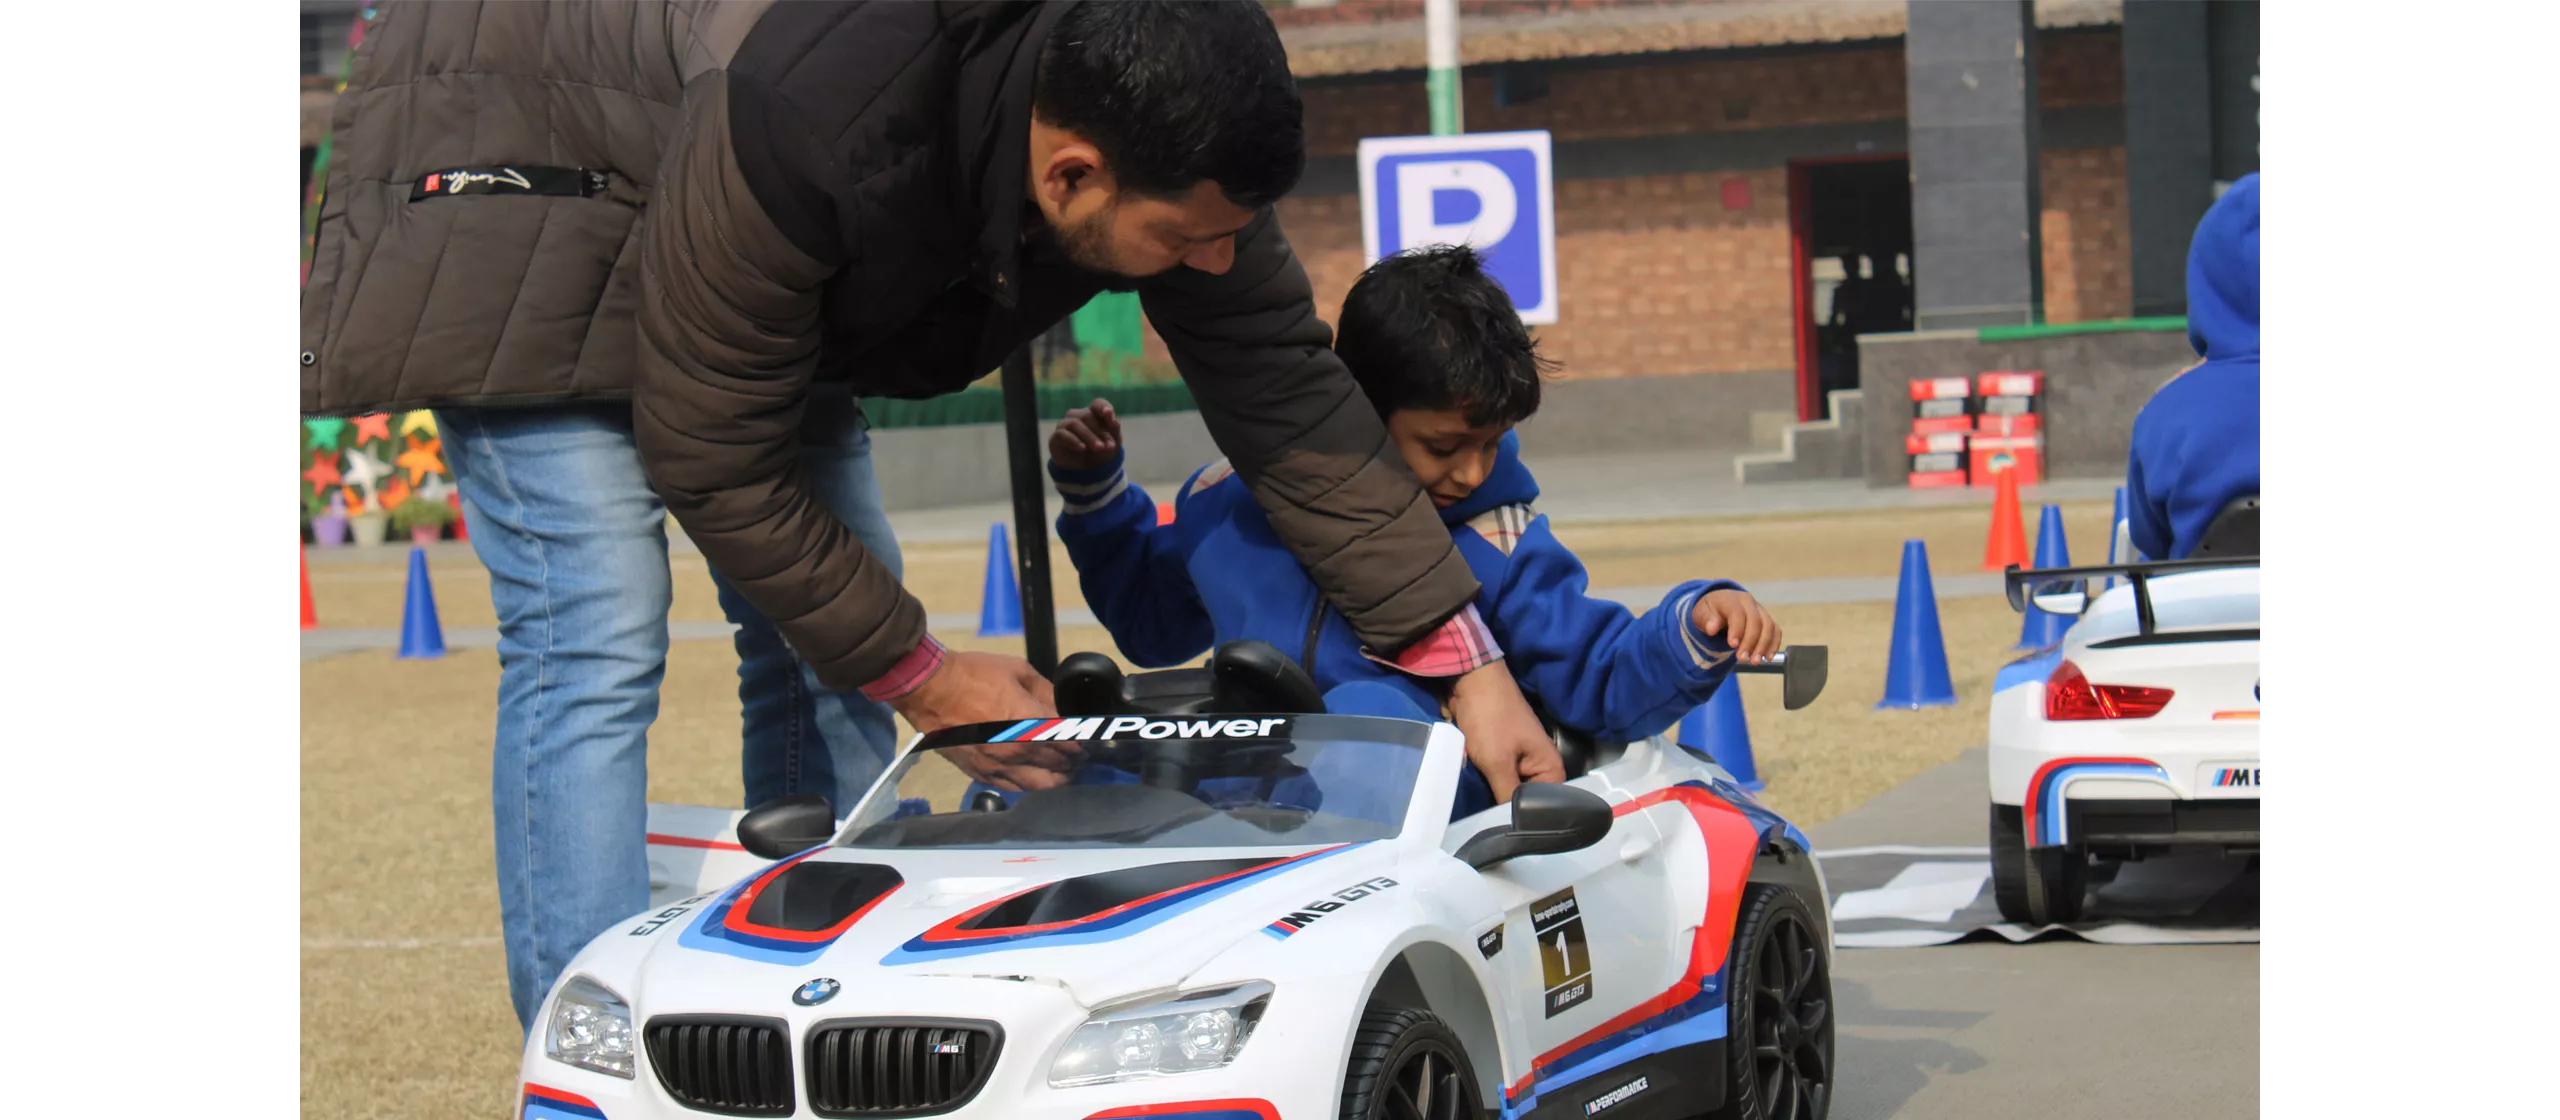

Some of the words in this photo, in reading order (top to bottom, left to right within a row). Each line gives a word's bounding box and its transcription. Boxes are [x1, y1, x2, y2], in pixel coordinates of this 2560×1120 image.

[1396, 160, 1518, 257] P
[1332, 876, 1400, 901] GT3
[1555, 930, 1571, 977] 1
